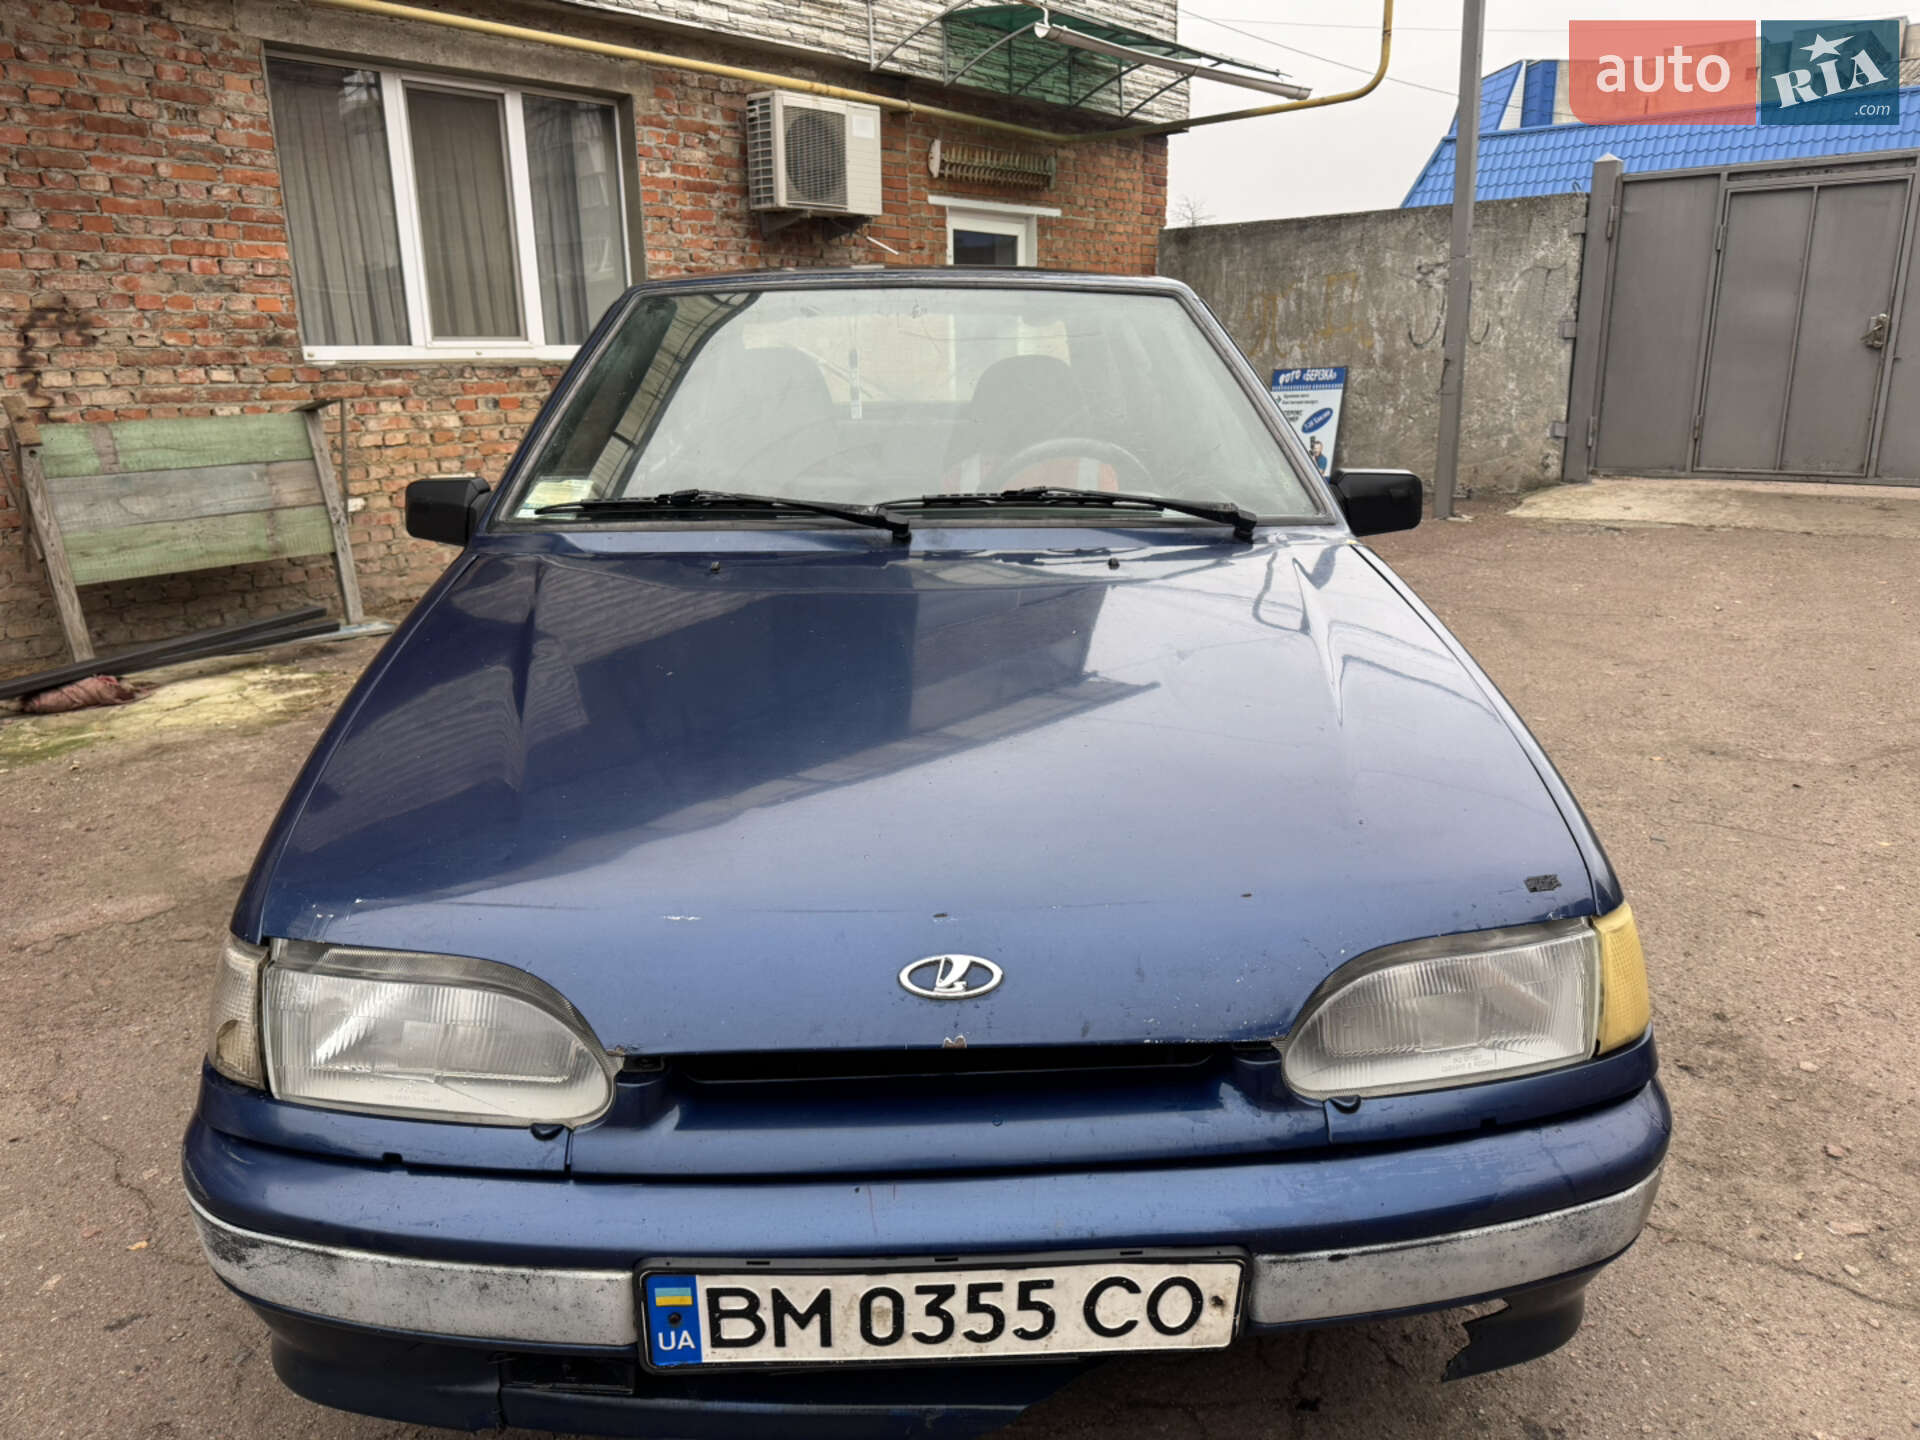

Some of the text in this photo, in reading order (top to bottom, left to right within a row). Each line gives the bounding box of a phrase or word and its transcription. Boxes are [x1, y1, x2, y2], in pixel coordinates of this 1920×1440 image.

[1279, 369, 1302, 385] ФОТО
[706, 1275, 1205, 1349] BM 0355 CO
[658, 1331, 696, 1352] UA
